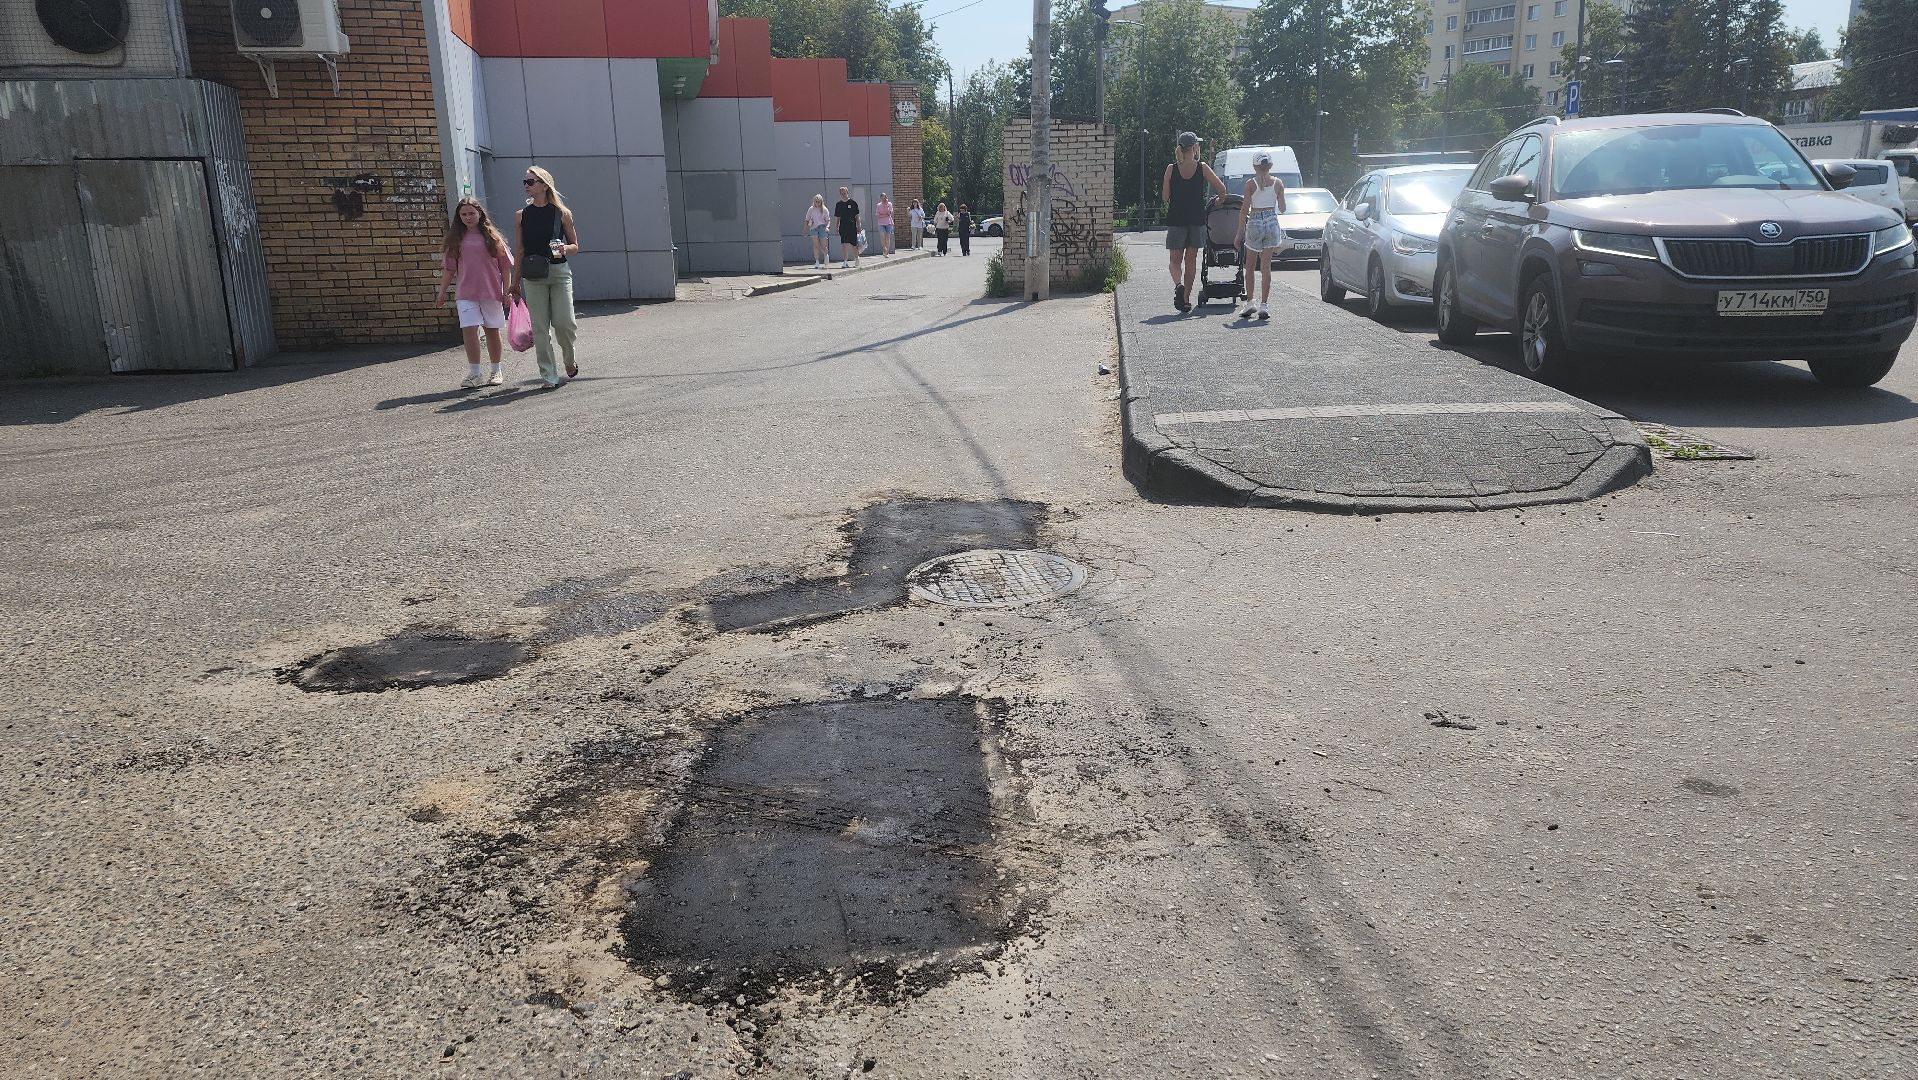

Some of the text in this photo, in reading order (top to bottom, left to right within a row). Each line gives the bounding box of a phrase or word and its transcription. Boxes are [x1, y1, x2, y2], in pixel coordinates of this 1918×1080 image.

[1569, 85, 1578, 111] P
[1790, 135, 1833, 148] тавка
[1798, 290, 1824, 303] 750
